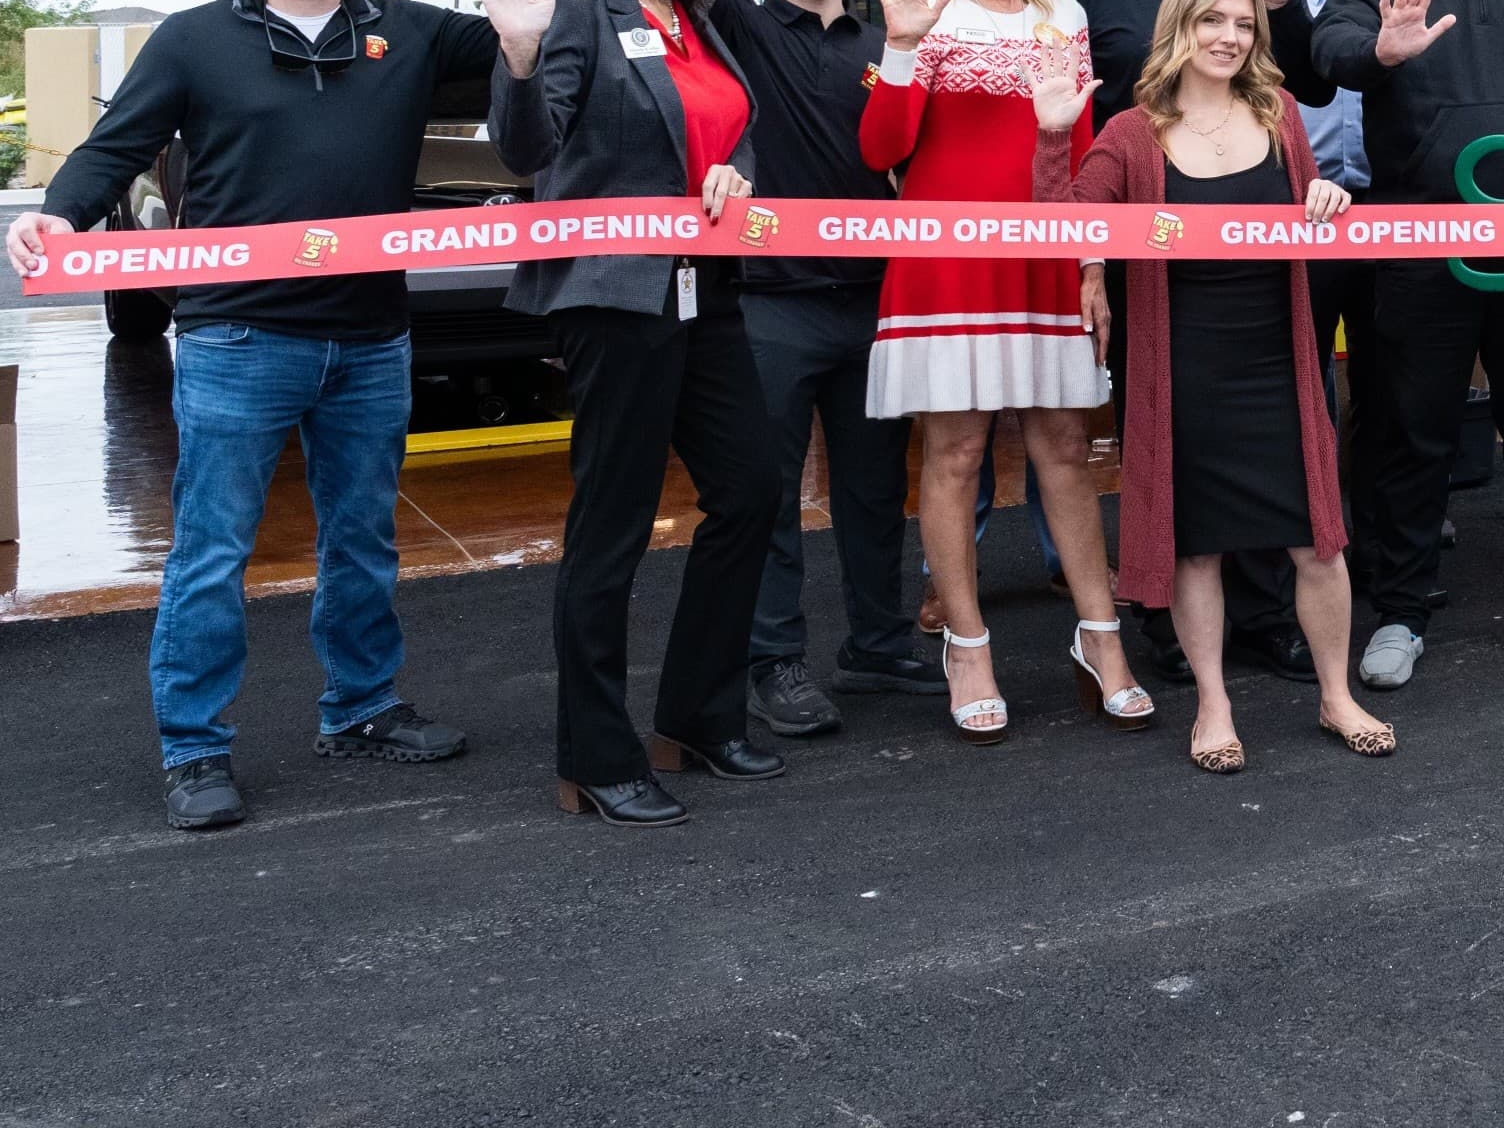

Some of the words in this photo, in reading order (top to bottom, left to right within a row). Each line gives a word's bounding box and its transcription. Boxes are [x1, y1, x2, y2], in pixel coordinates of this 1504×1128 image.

[747, 210, 771, 226] TAKE
[1153, 215, 1177, 230] TAKE
[382, 222, 517, 254] GRAND
[530, 214, 699, 243] OPENING
[747, 223, 762, 238] 5
[818, 216, 942, 242] GRAND
[953, 218, 1109, 243] OPENING
[1153, 227, 1169, 242] 5
[1220, 221, 1337, 245] GRAND
[1348, 219, 1496, 244] OPENING
[304, 232, 330, 246] TAKE
[302, 245, 320, 259] 5
[63, 244, 250, 276] OPENING
